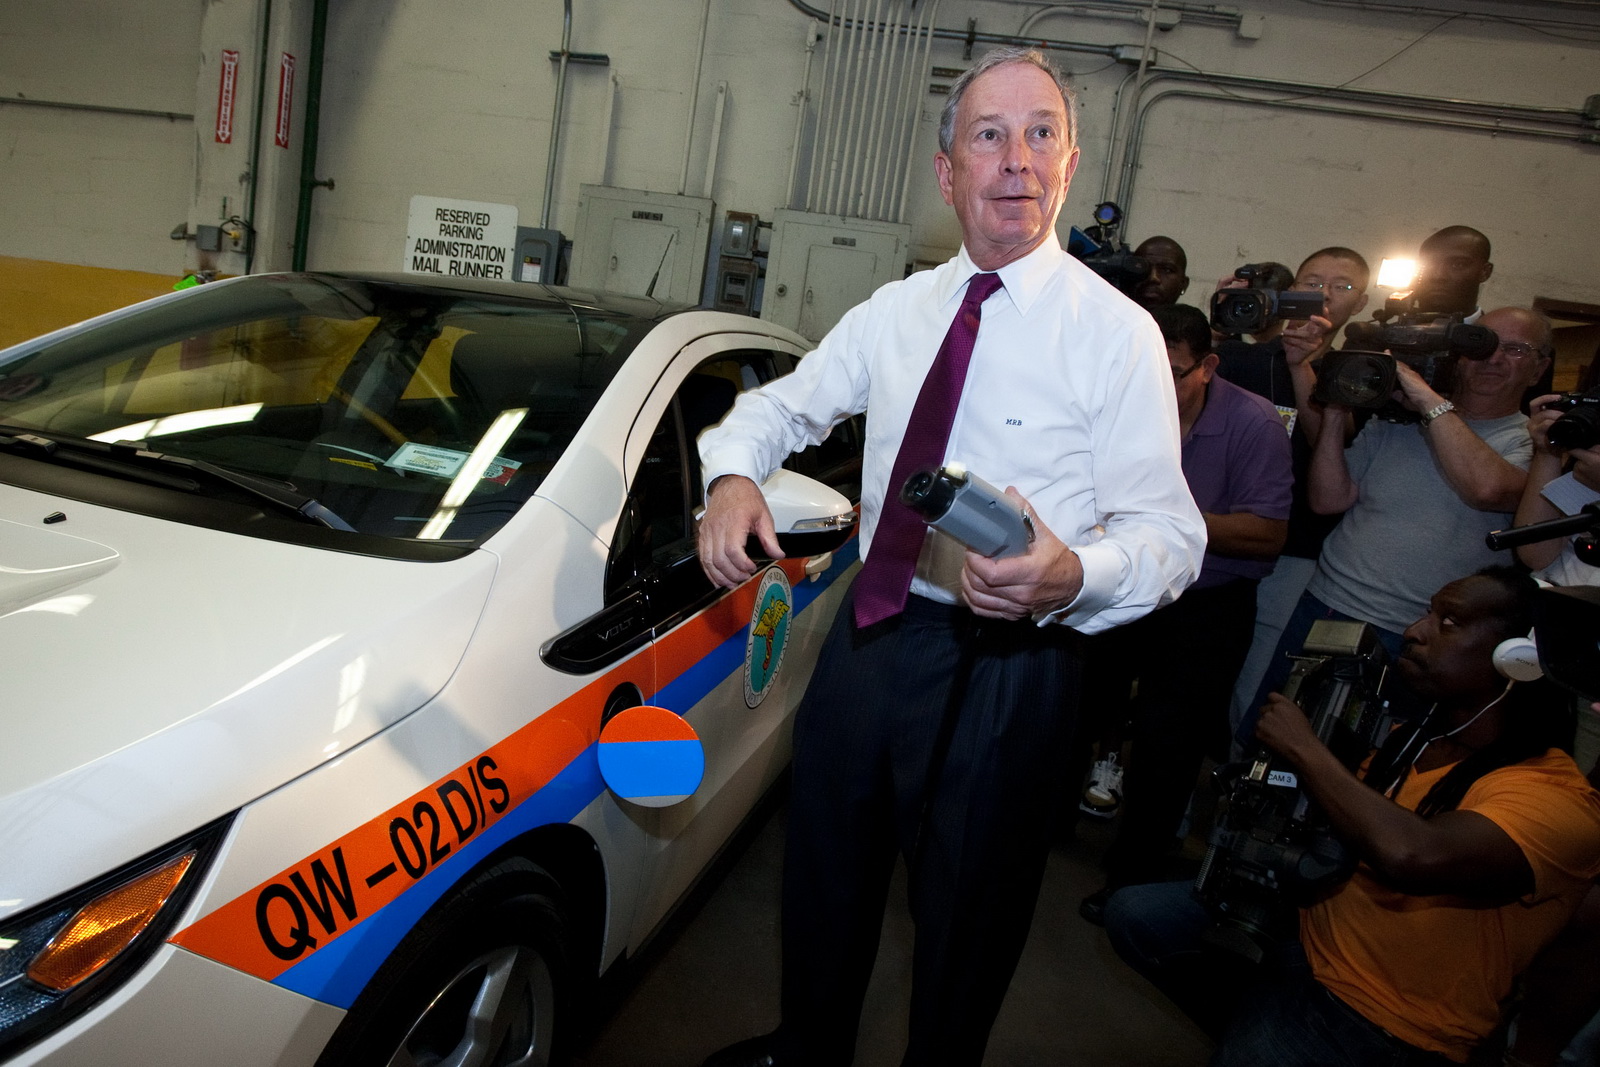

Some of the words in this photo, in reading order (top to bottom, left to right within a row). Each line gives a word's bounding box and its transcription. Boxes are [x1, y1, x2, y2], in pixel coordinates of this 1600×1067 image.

[435, 207, 491, 226] RESERVED
[439, 223, 484, 241] PARKING
[414, 238, 506, 263] ADMINISTRATION
[412, 255, 443, 274] MAIL
[449, 260, 504, 280] RUNNER
[1005, 418, 1022, 426] MRB
[596, 616, 634, 642] VOLT
[1268, 773, 1285, 782] CAM
